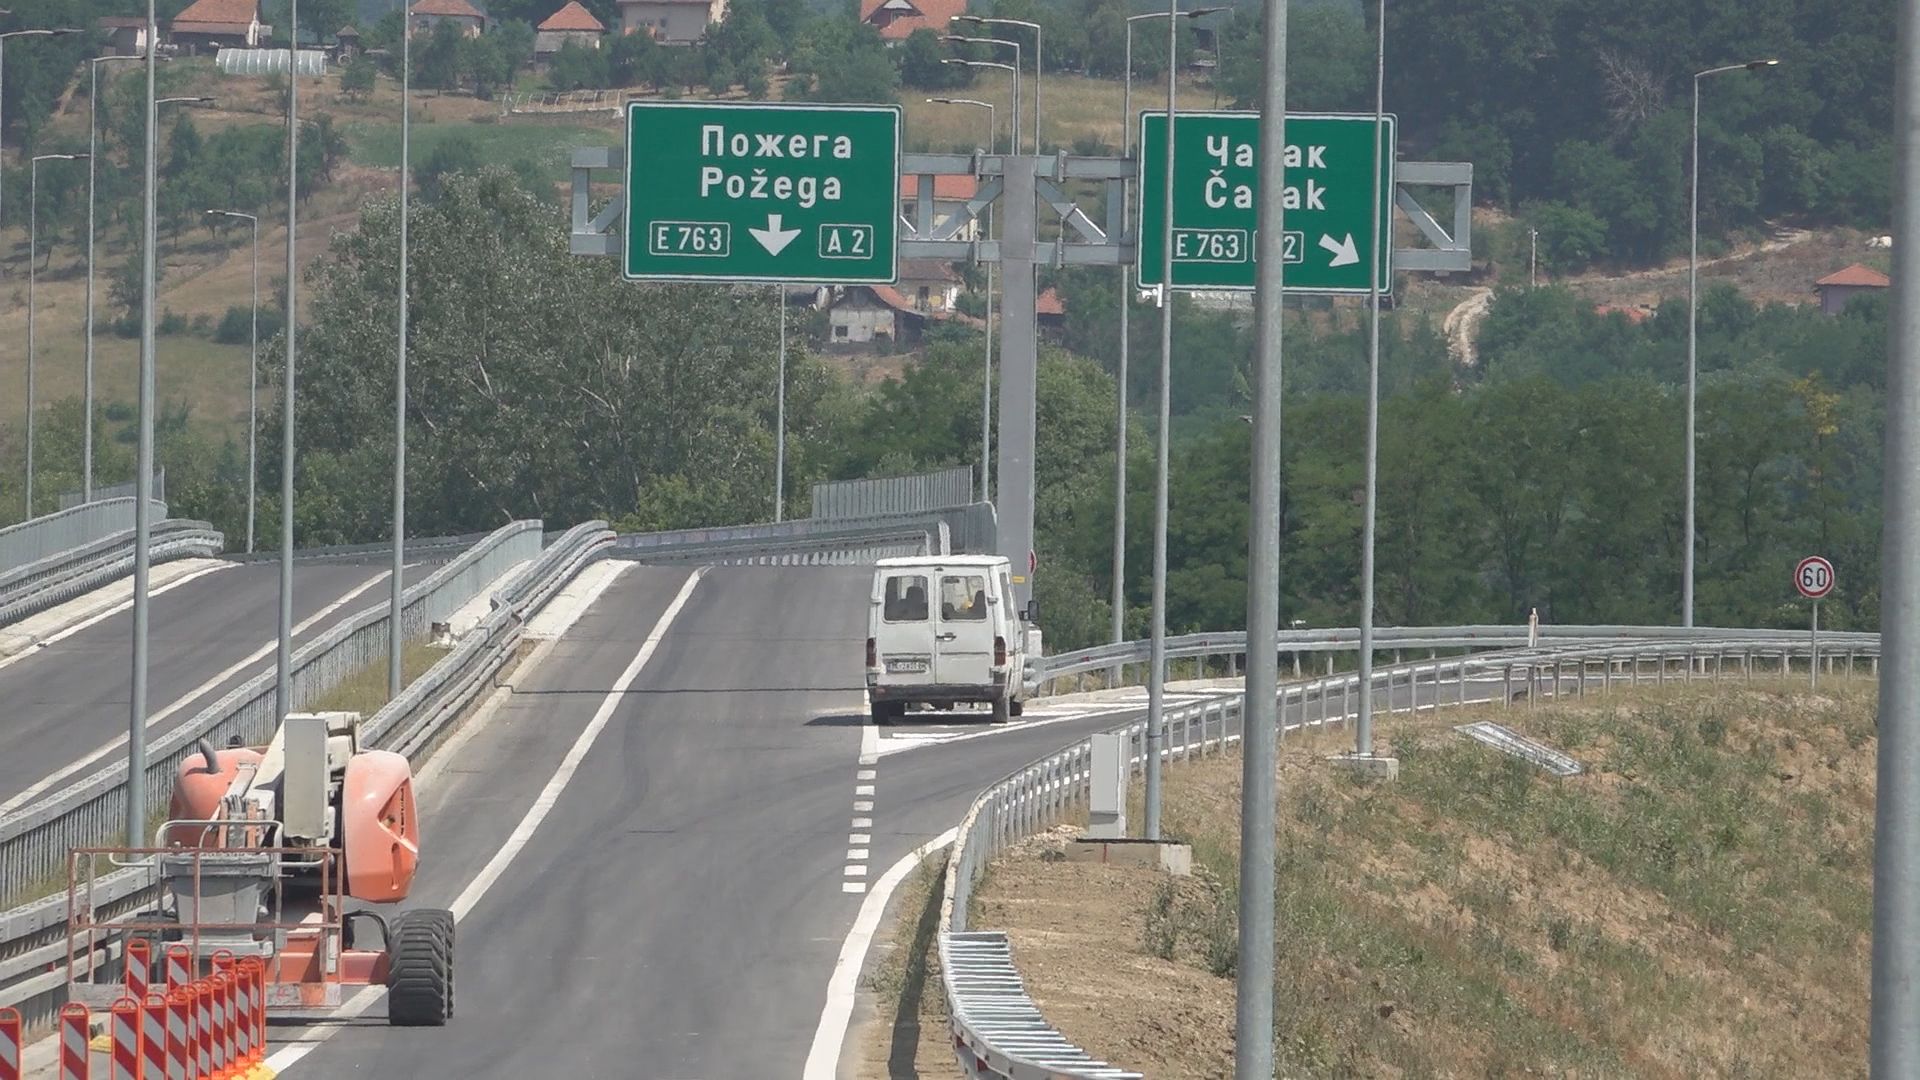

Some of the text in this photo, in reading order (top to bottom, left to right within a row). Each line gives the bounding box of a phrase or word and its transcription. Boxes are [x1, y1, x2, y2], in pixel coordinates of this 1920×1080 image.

[702, 125, 851, 159] Пожега
[1206, 135, 1327, 169] Чаак
[701, 167, 841, 208] Požega
[1205, 169, 1326, 210] Čaak
[657, 227, 722, 251] E 763
[827, 229, 864, 253] A 2
[1176, 233, 1239, 258] E 763
[1283, 235, 1296, 259] 2
[1803, 567, 1826, 587] 60
